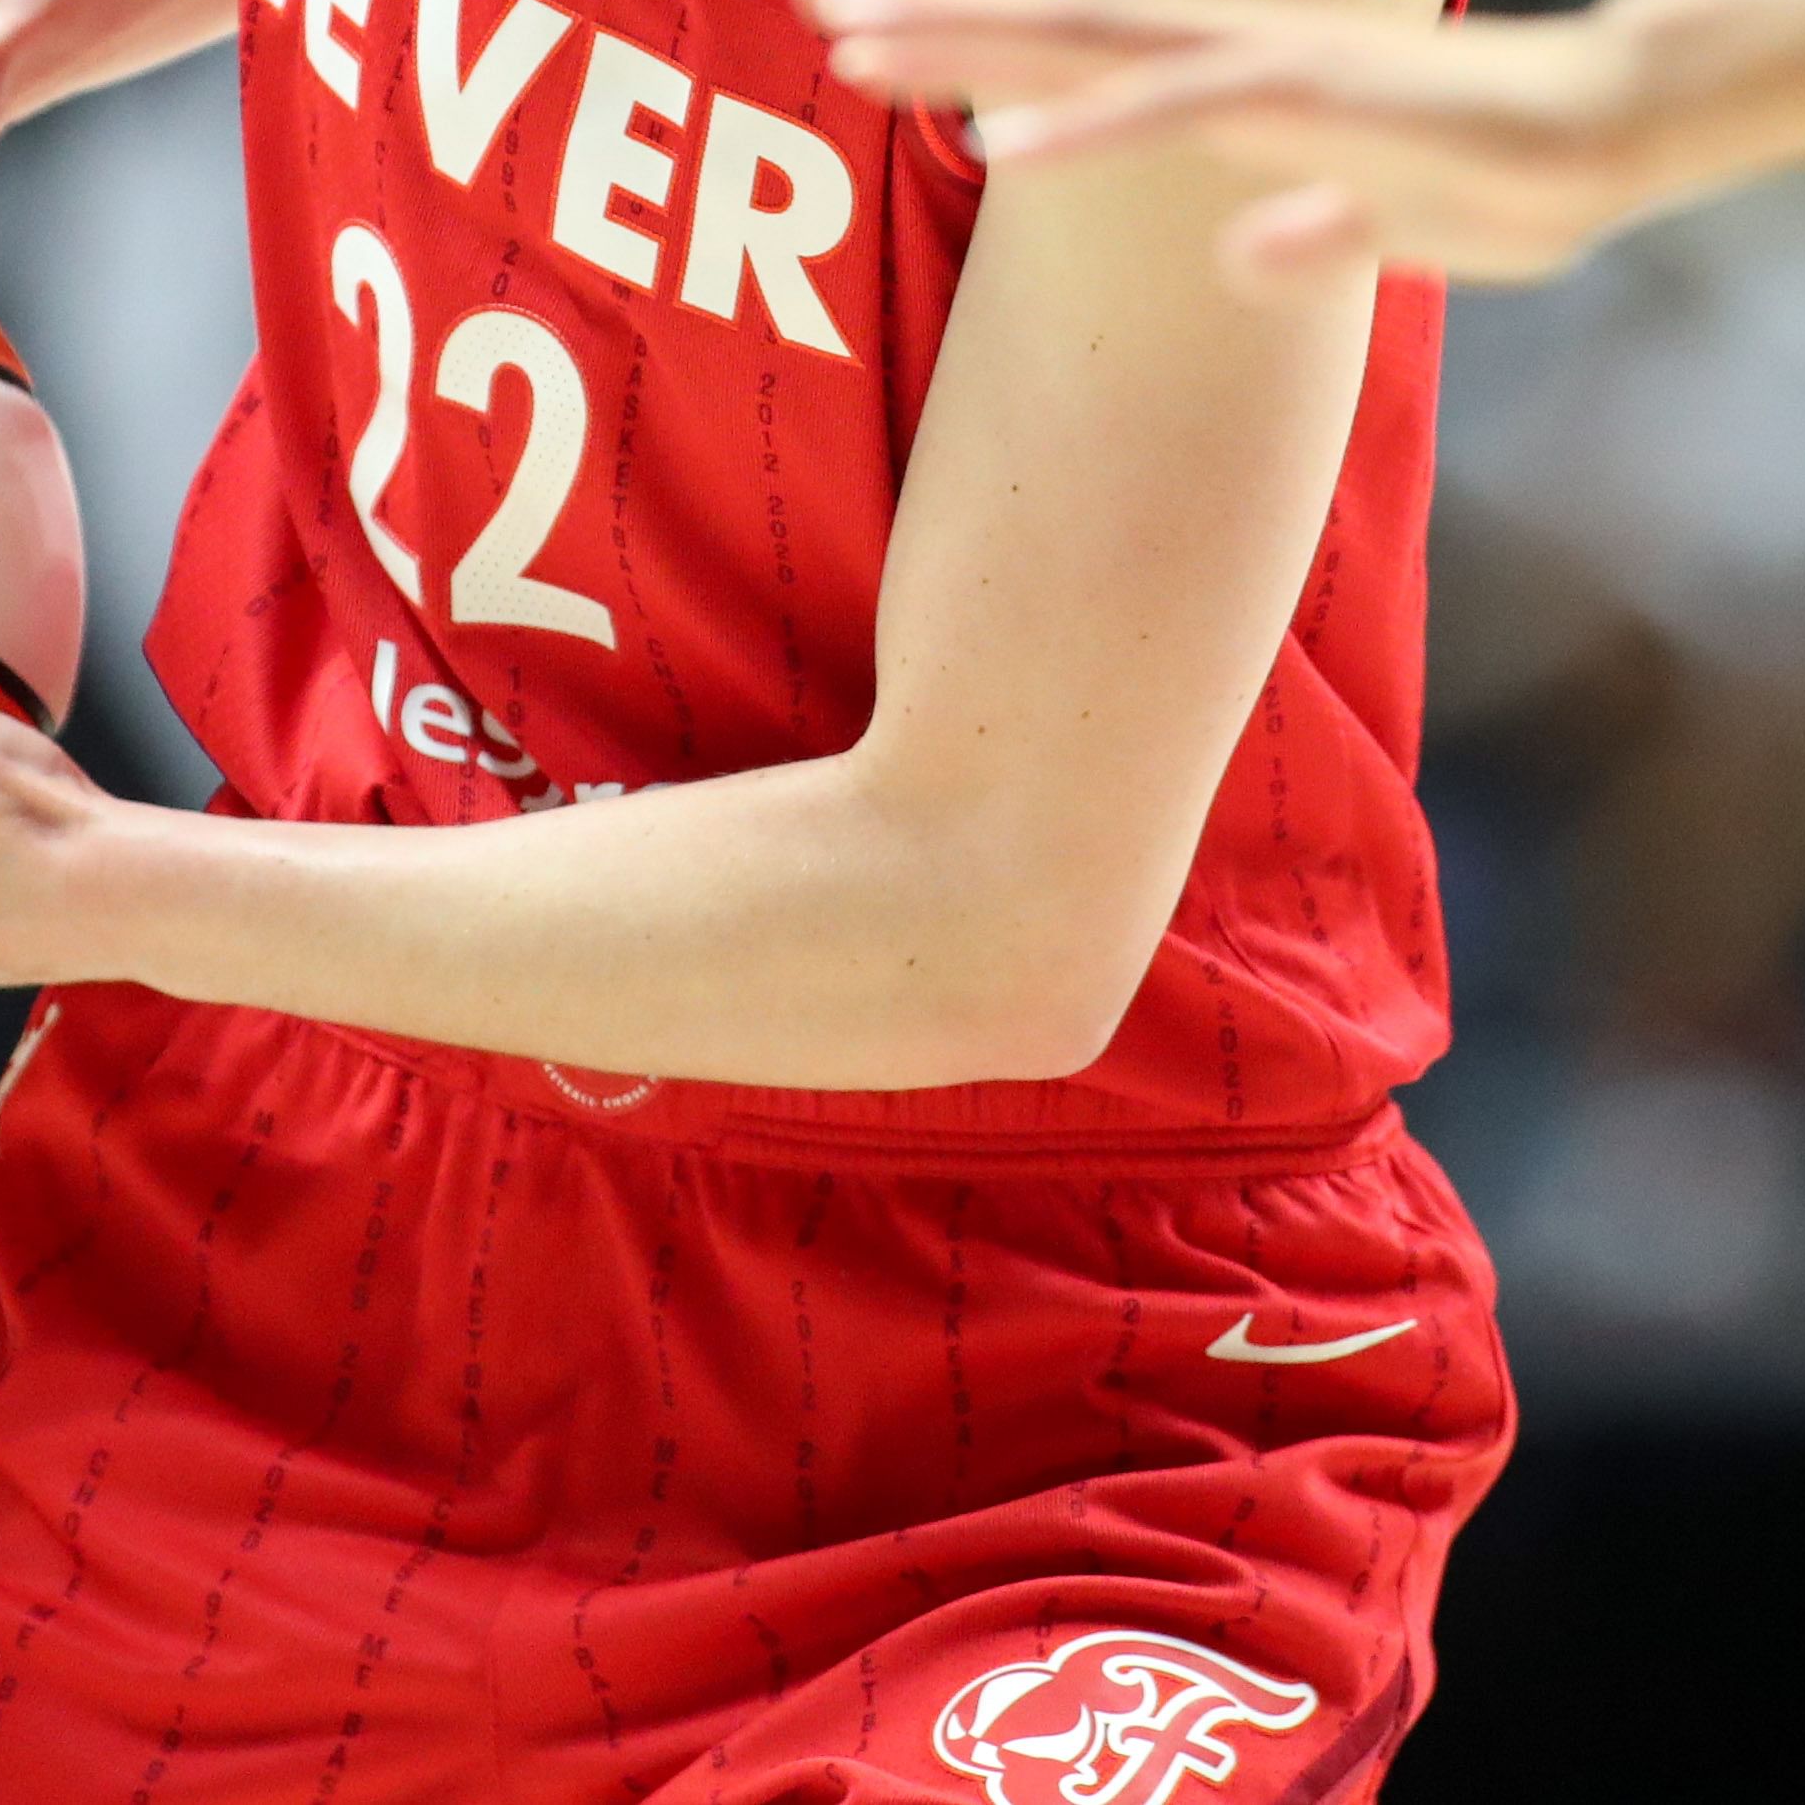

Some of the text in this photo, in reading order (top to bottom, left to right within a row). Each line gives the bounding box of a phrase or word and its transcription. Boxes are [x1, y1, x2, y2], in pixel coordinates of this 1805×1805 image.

[331, 222, 616, 651] 22
[610, 332, 649, 621] BASKETBALL
[757, 372, 778, 474] 2012
[766, 494, 796, 586] 2020
